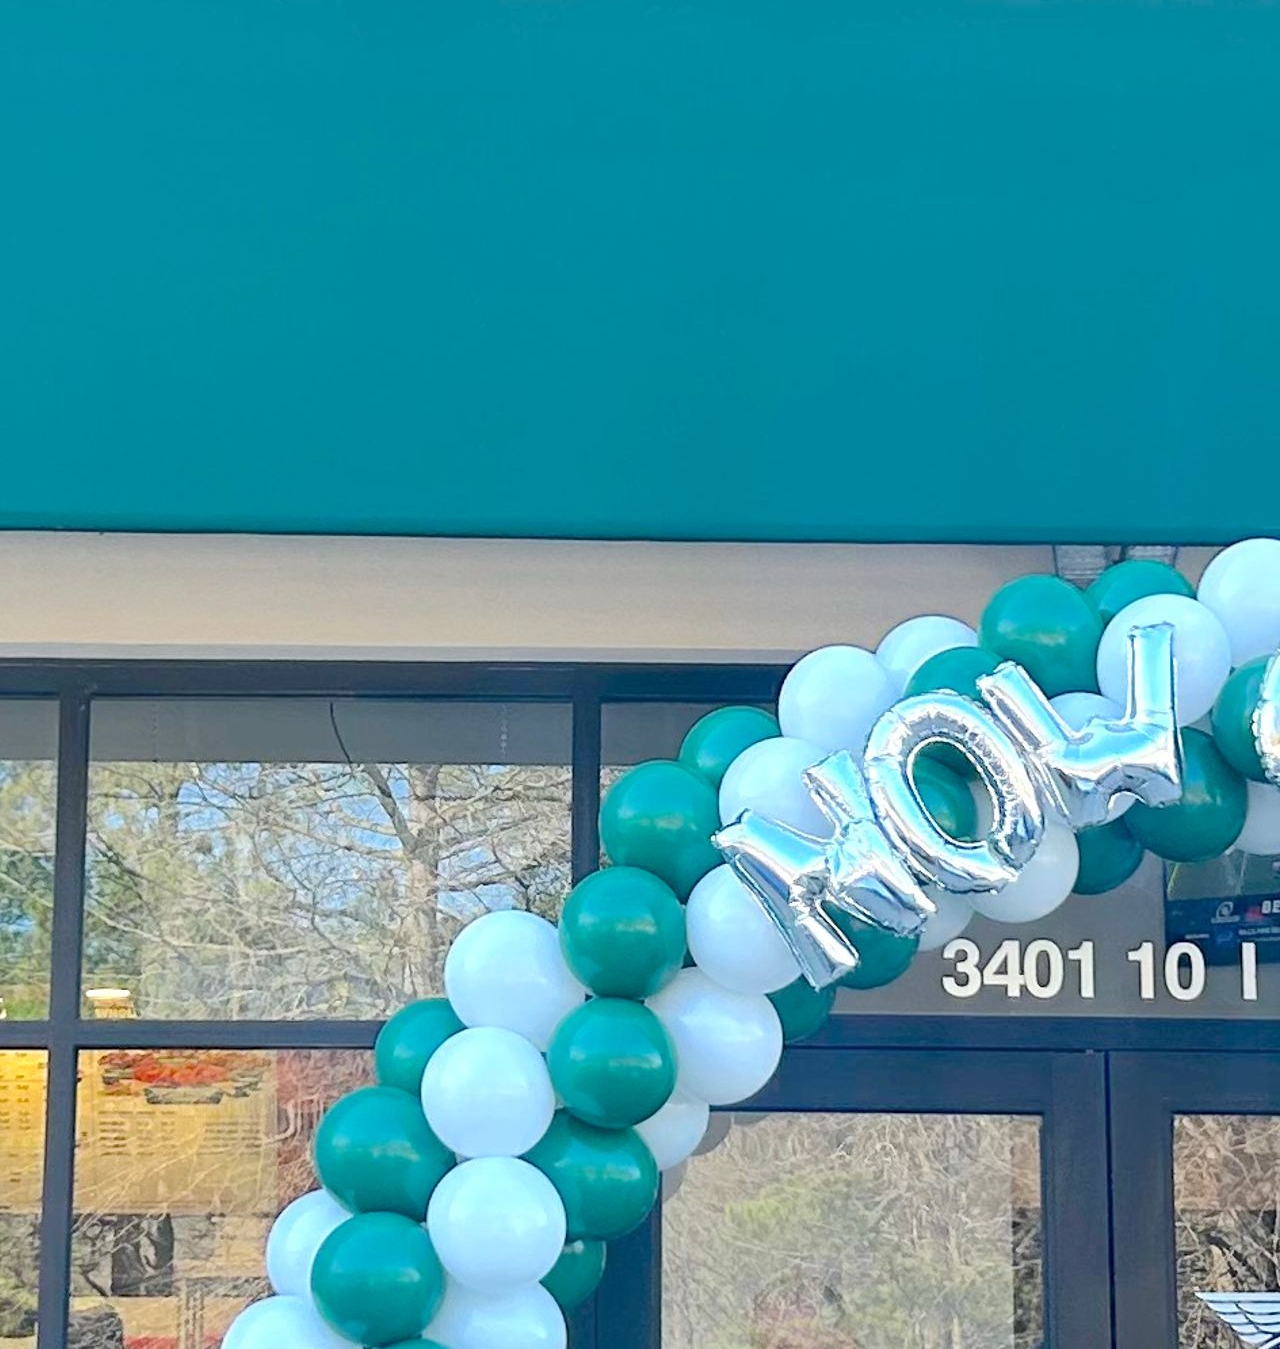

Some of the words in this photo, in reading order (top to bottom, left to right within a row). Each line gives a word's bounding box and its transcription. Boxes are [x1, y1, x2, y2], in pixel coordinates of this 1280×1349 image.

[712, 622, 1184, 991] NOW
[942, 938, 1096, 999] 3401
[1127, 941, 1206, 1001] 10
